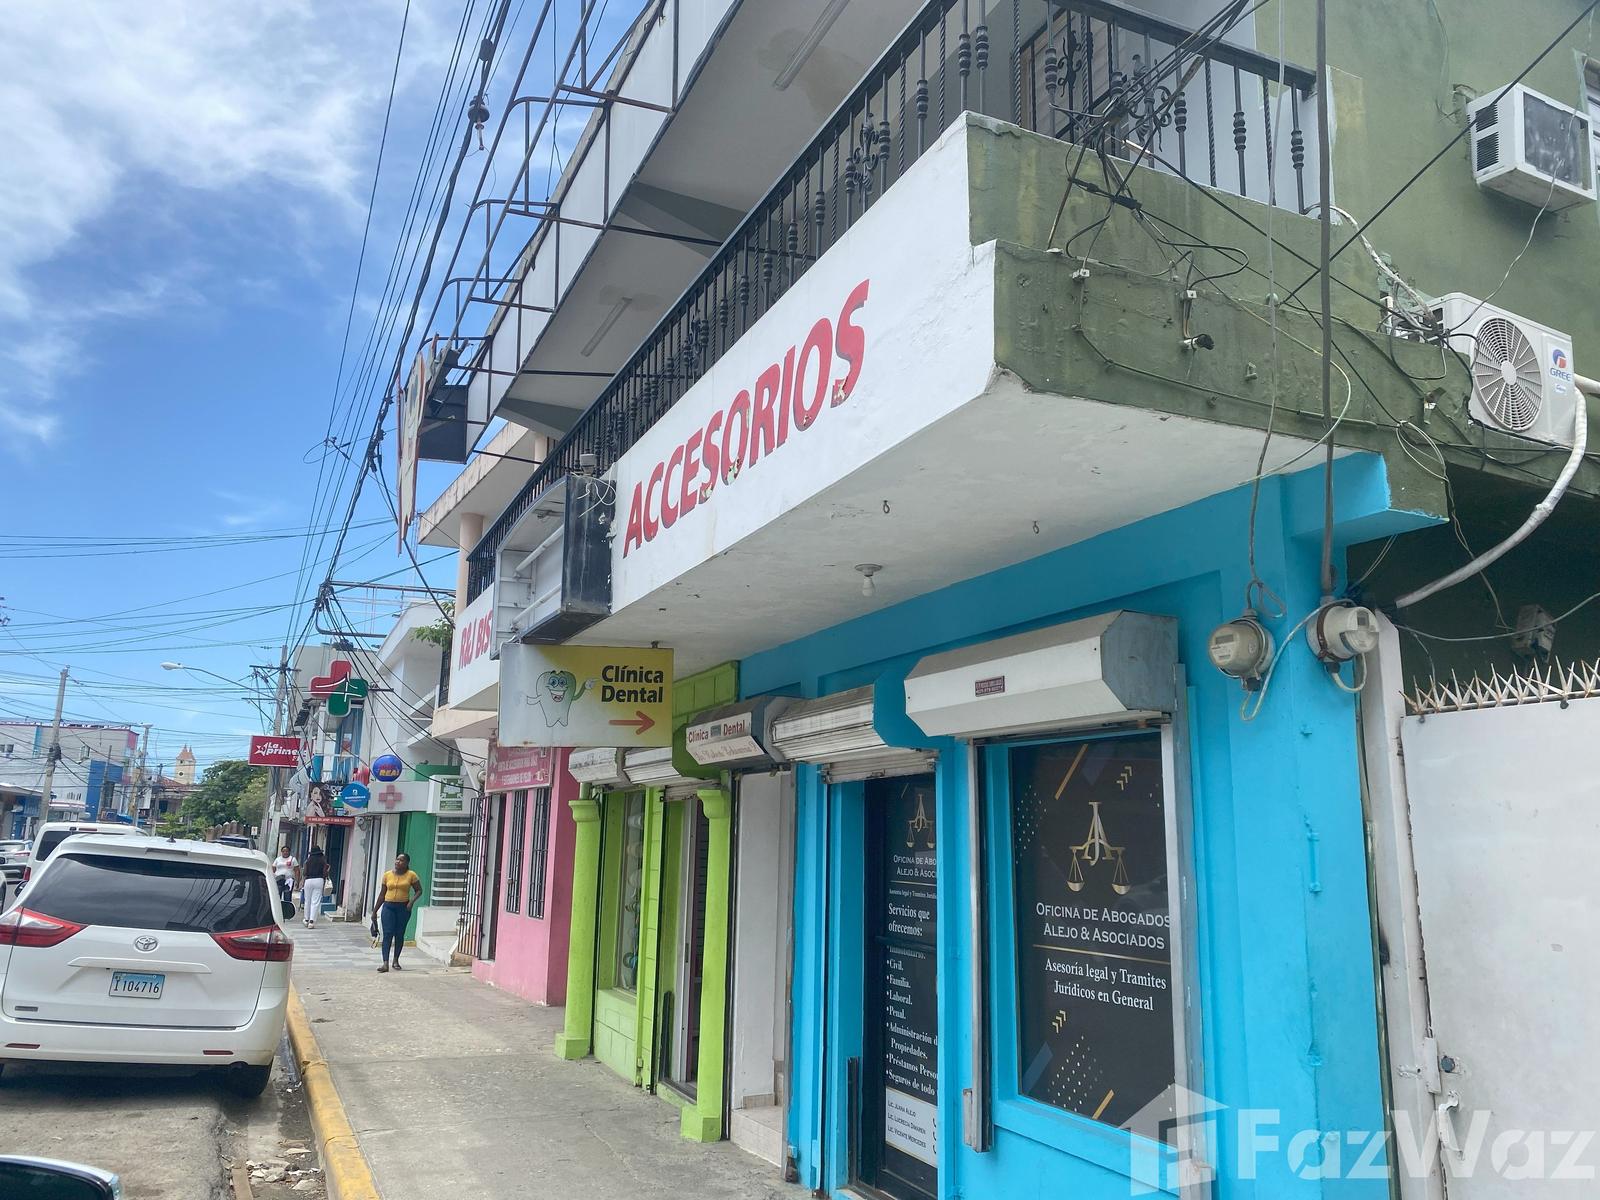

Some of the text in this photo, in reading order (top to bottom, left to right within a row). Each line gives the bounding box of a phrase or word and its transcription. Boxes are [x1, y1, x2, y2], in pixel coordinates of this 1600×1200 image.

[1550, 367, 1572, 382] GREE
[622, 279, 870, 559] ACCESORIOS
[602, 665, 664, 684] Clínica
[602, 685, 664, 703] Dental
[723, 720, 745, 736] Dental
[893, 854, 914, 864] OFICINA
[915, 857, 924, 865] DE
[896, 866, 914, 876] ALEJO
[888, 902, 930, 922] Servicios que
[1036, 902, 1170, 928] OFICINA DE ABOGADOS
[888, 920, 923, 937] ofrecemos:
[1043, 923, 1165, 950] ALEJO & ASOCIADOS
[1045, 958, 1167, 990] Asesoría legal y Tramites
[1054, 980, 1154, 1011] Jurídicos en General
[889, 1053, 919, 1073] Préstamos
[888, 1069, 936, 1096] Seguros de todo
